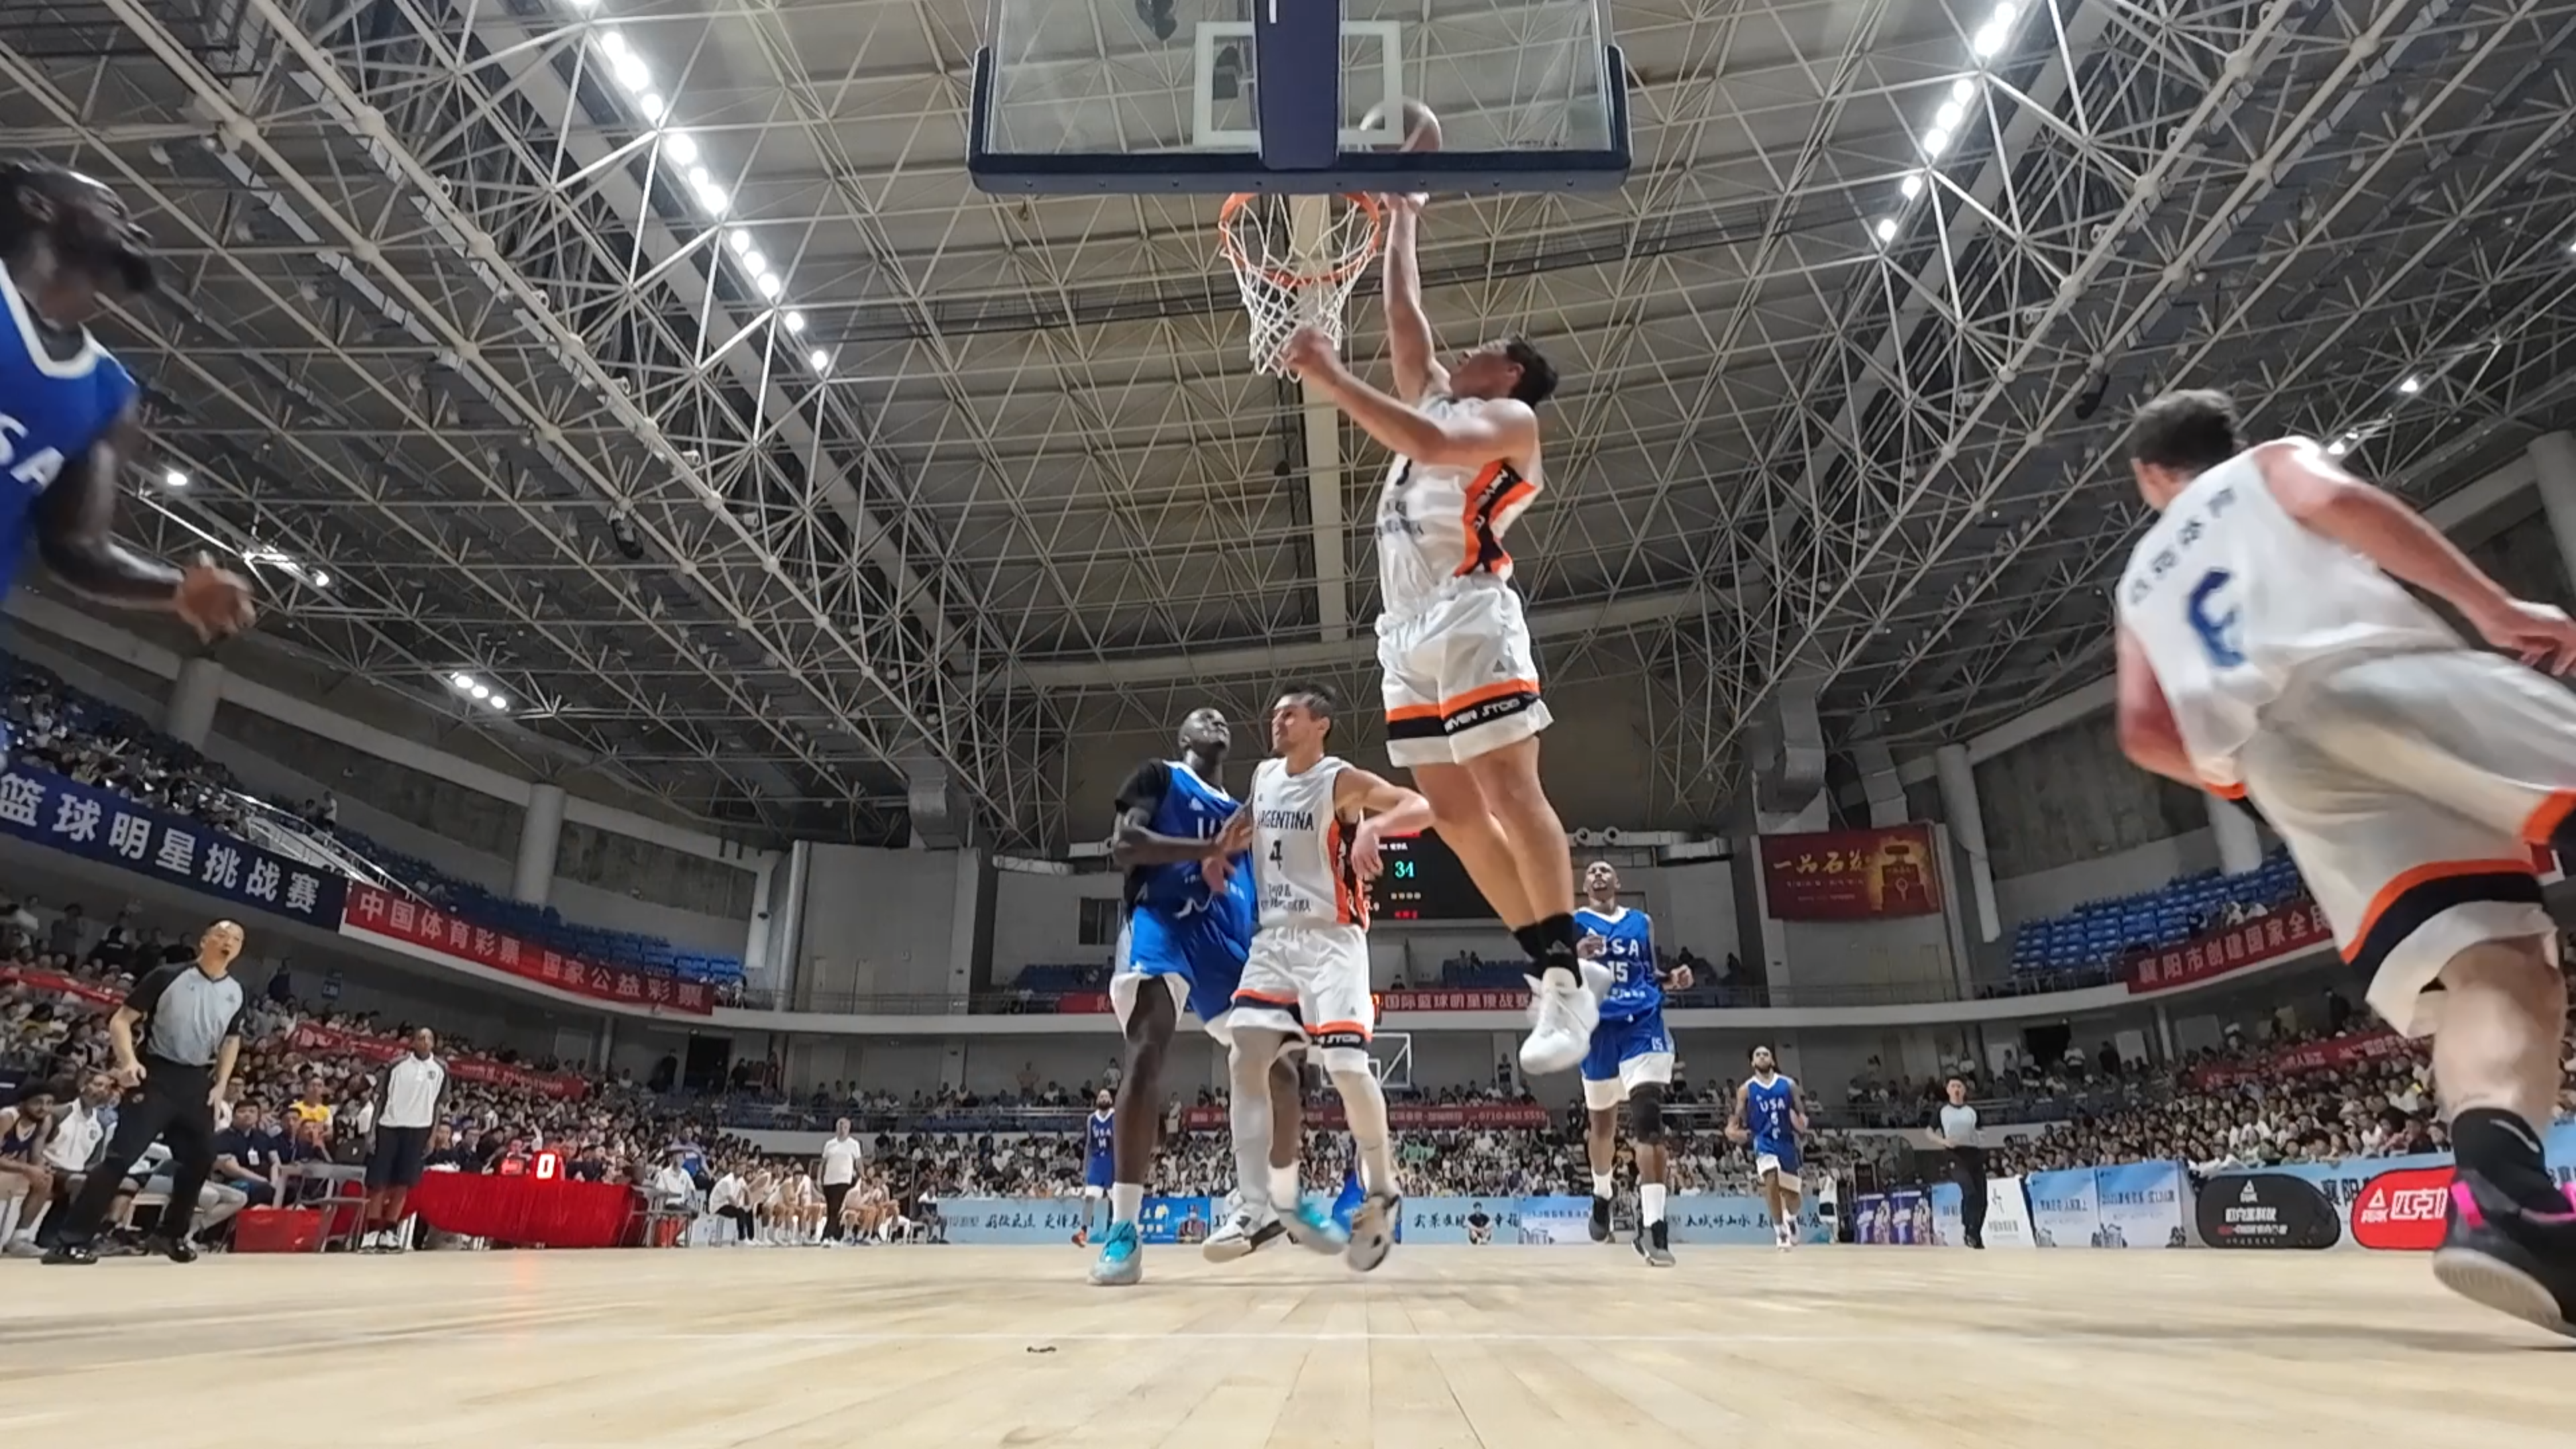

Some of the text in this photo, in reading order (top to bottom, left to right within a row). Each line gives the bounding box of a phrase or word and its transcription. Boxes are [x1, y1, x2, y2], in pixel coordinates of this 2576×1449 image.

[0, 773, 319, 912] 篮球明星挑战赛
[1269, 840, 1283, 870] 4
[360, 892, 704, 1006] 中国体育彩票 国家公益彩票
[2137, 905, 2331, 983] 襄阳市创建国家全民
[1607, 960, 1629, 983] 15
[1760, 1097, 1786, 1113] USA
[537, 1153, 555, 1179] 0
[2321, 1177, 2371, 1206] 襄阳
